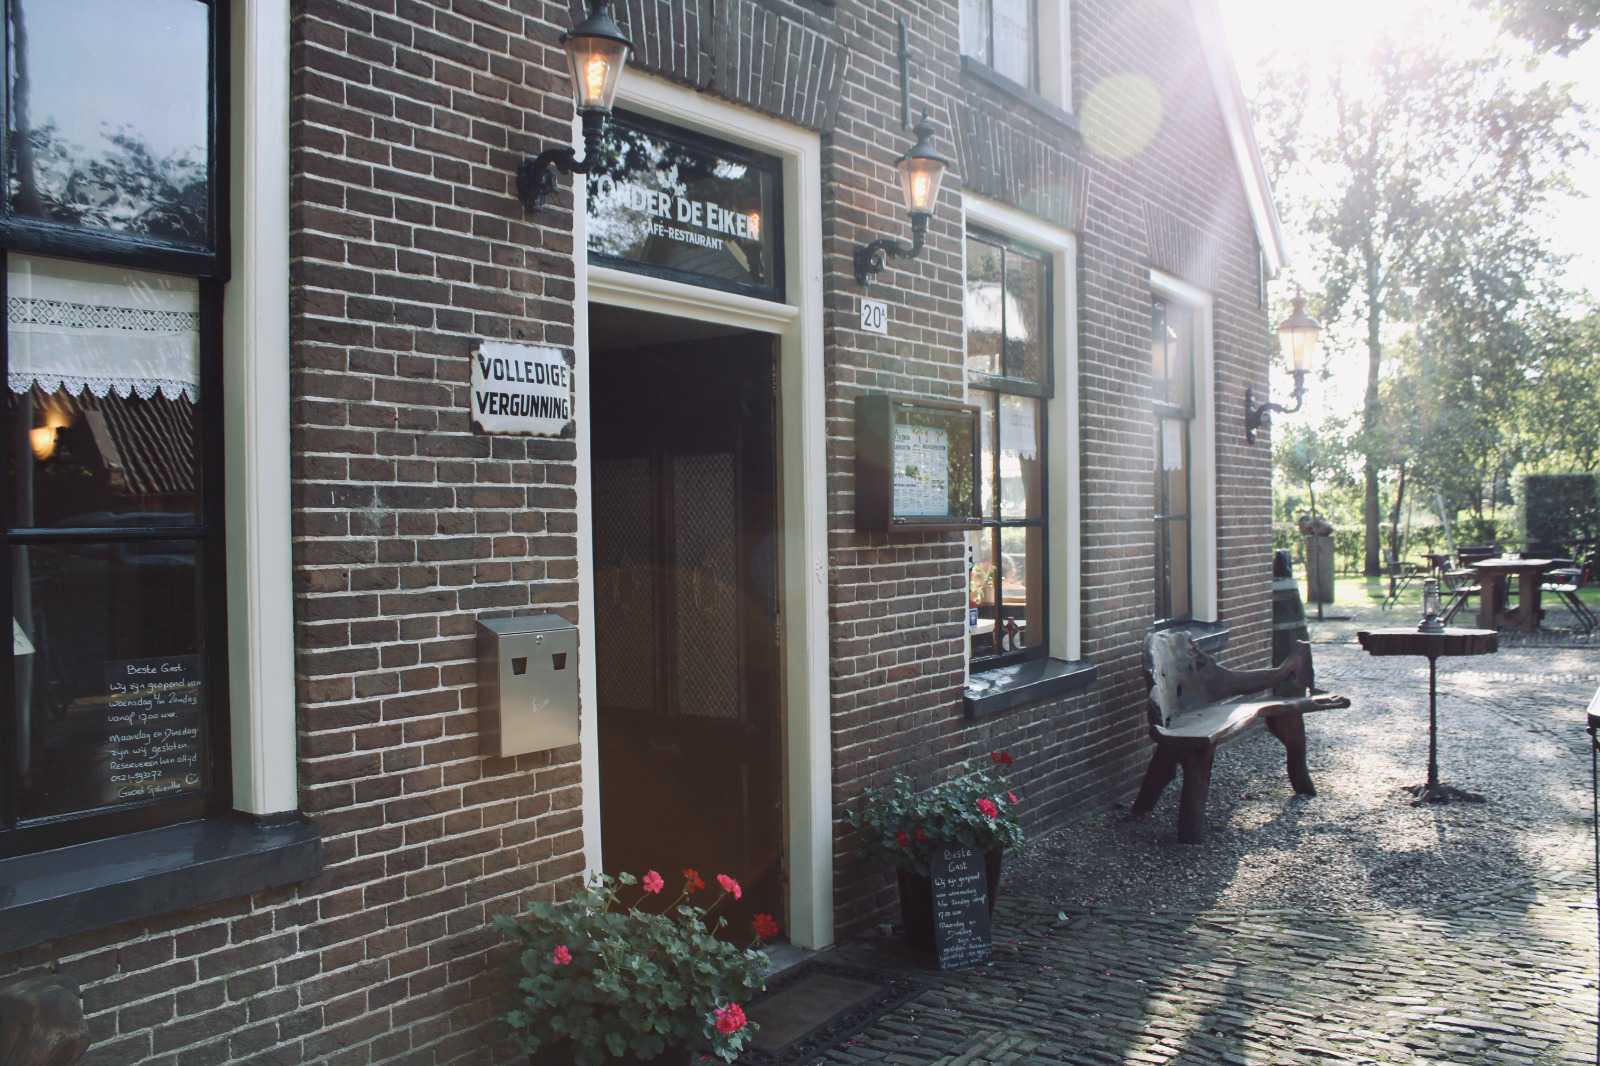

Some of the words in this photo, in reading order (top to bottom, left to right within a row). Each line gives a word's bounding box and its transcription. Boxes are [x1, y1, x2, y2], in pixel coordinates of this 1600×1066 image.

[677, 197, 703, 227] DE
[706, 201, 760, 241] EIKEN
[477, 352, 568, 388] VOLLEDIGE
[475, 390, 569, 420] VERGUNNING
[127, 664, 157, 675] Beste
